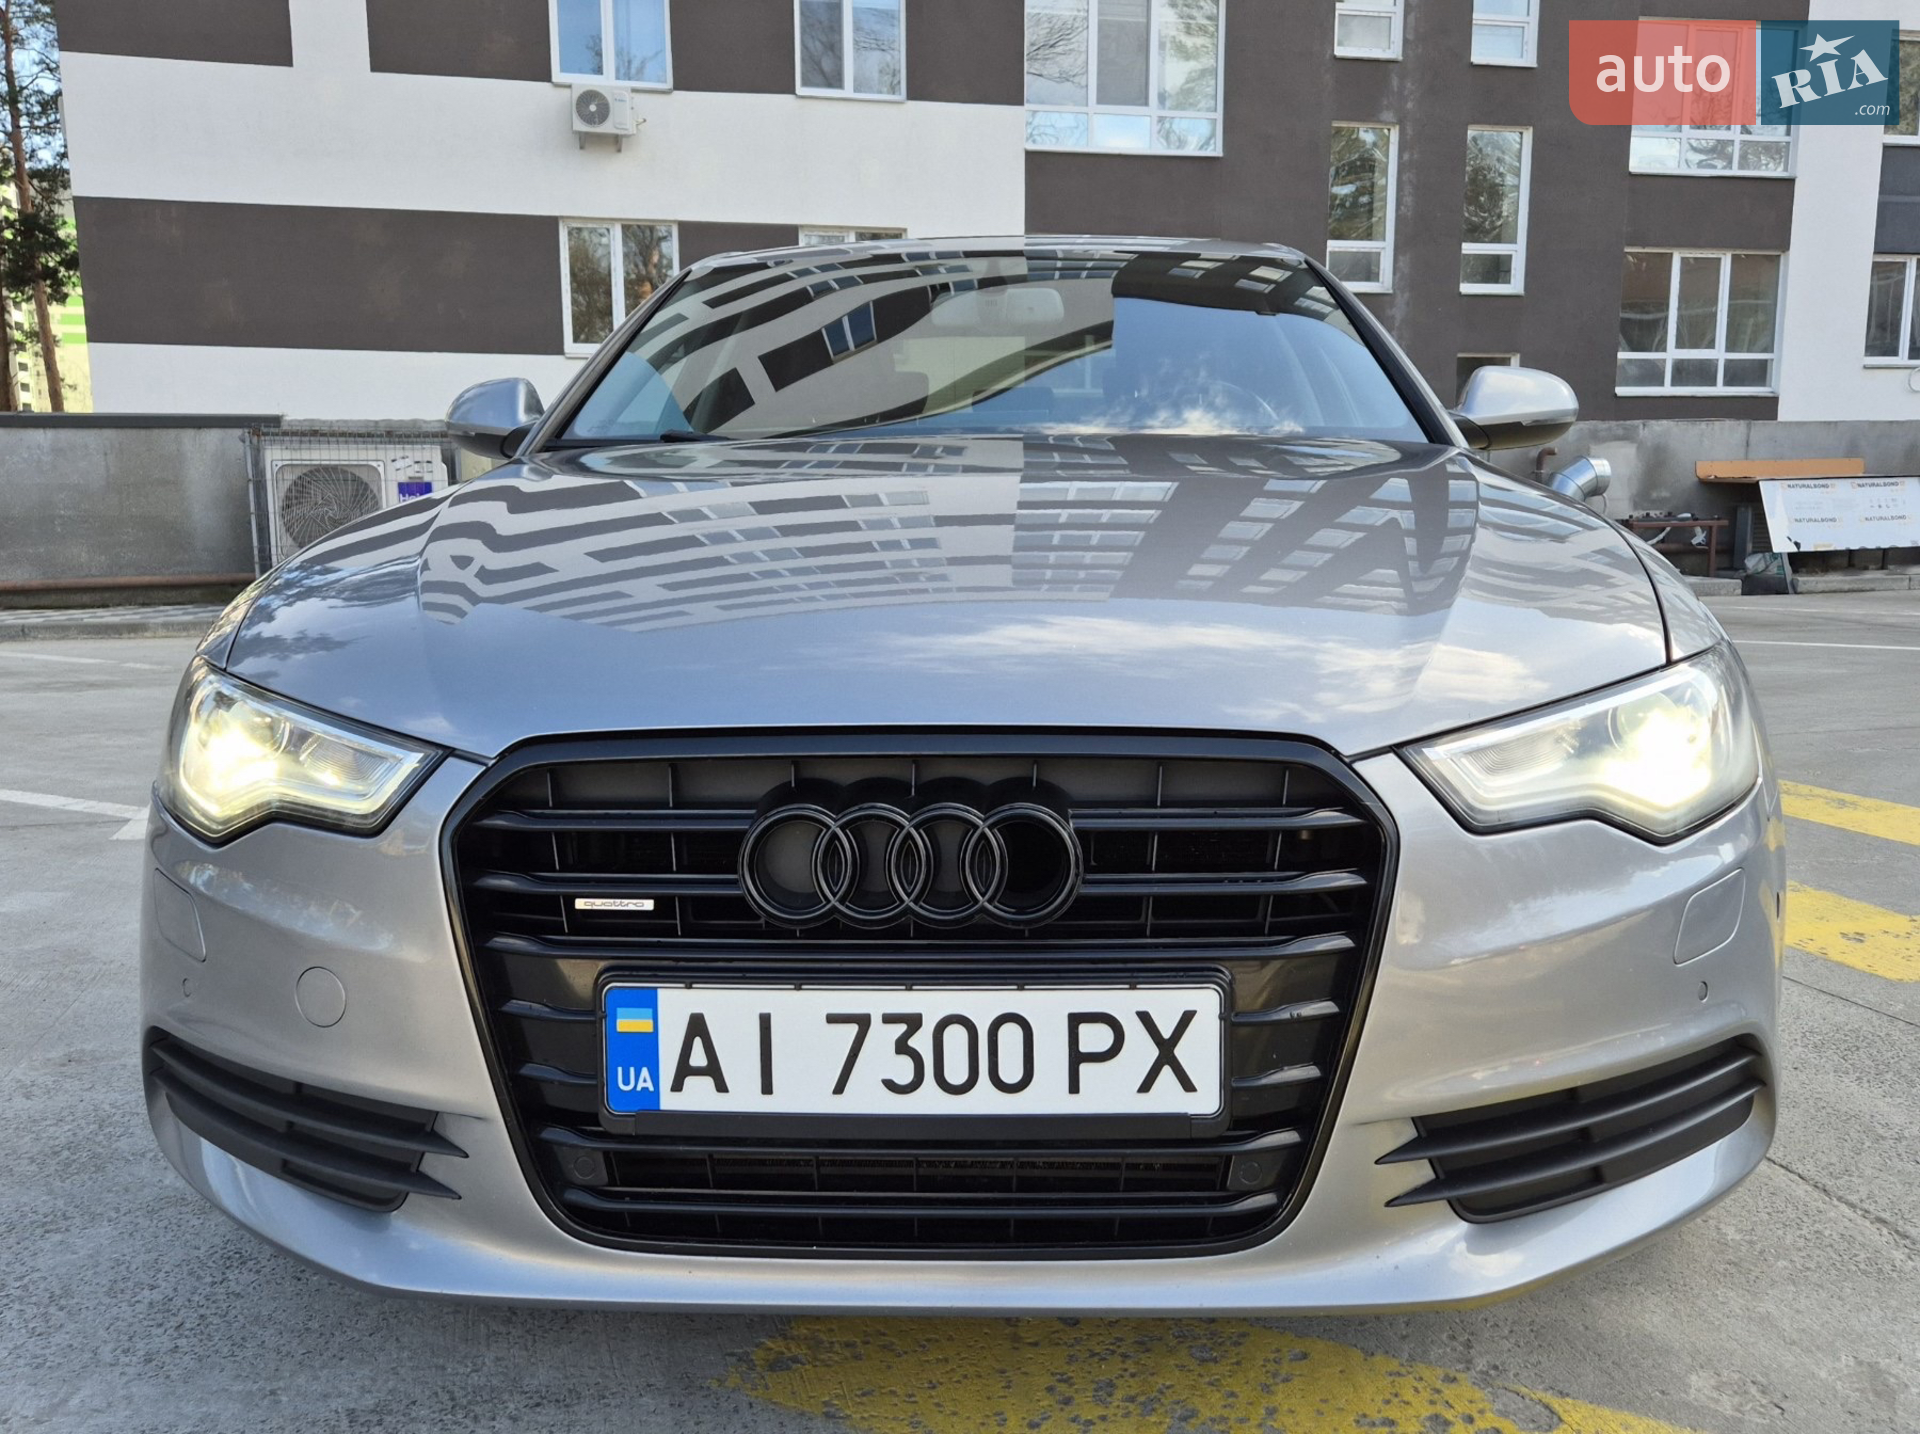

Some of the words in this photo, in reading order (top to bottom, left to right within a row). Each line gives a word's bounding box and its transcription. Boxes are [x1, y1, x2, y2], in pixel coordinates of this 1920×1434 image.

[1857, 480, 1900, 488] NATURALBOND
[583, 900, 645, 909] quattro
[669, 1011, 773, 1096] AI
[824, 1012, 1035, 1096] 7300
[1068, 1009, 1199, 1095] PX
[617, 1066, 655, 1093] UA
